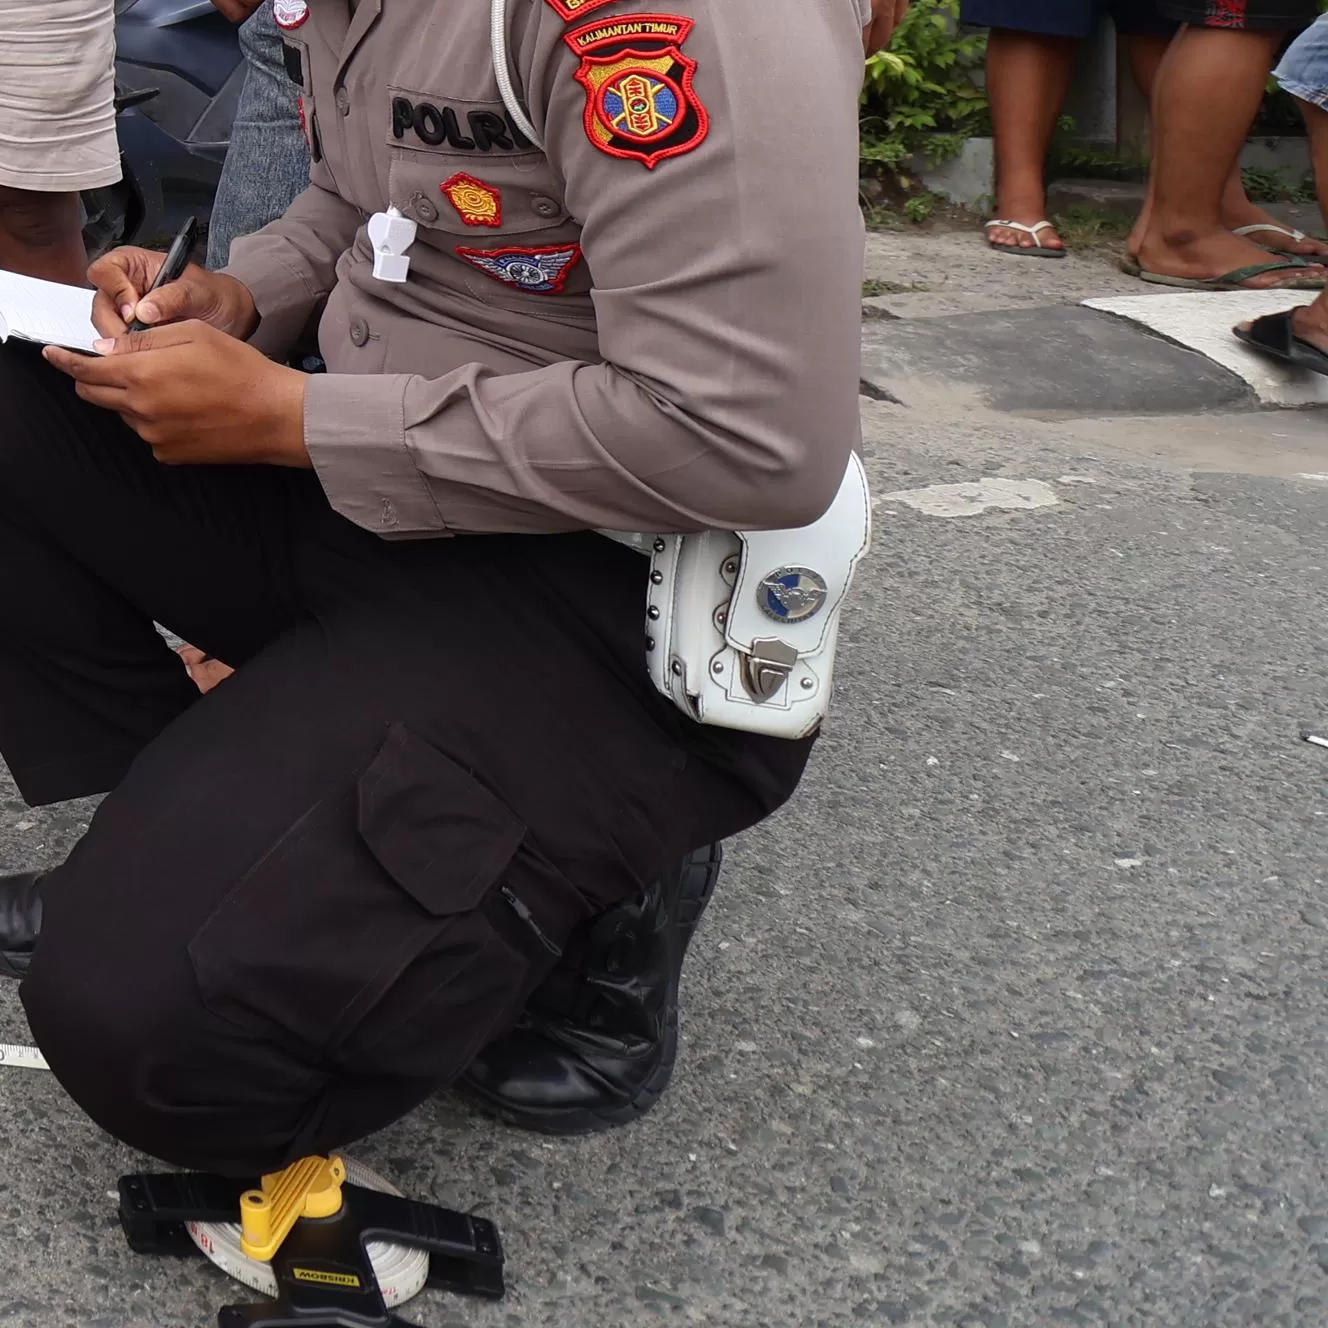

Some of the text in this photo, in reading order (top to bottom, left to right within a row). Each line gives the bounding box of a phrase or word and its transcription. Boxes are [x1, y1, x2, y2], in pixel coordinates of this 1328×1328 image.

[578, 22, 678, 46] KALIMANTAN TIMUR
[393, 97, 535, 150] POLRI
[299, 1271, 355, 1284] KRISBOW
